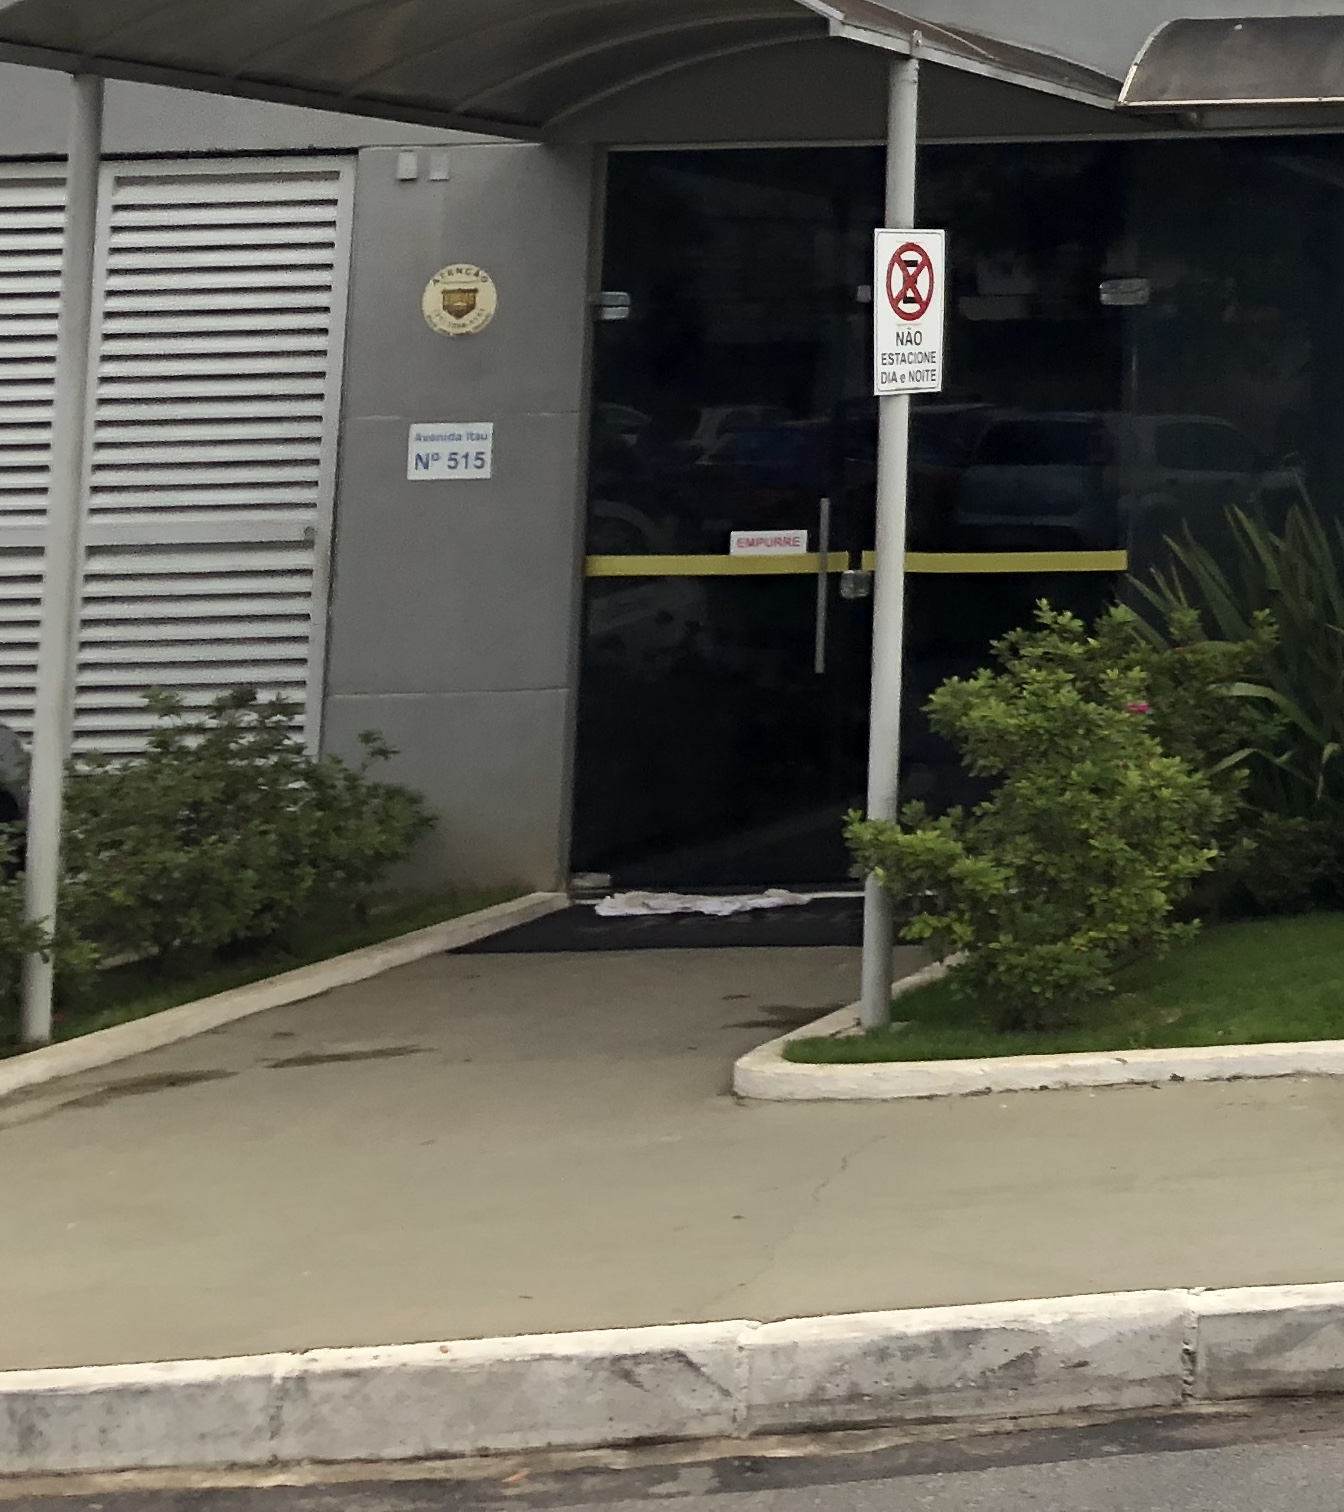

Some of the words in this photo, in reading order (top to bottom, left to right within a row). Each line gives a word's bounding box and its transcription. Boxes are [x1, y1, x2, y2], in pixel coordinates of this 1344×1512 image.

[896, 327, 923, 347] NÃO
[881, 350, 937, 367] ESTACIONE
[880, 370, 898, 385] DIA
[908, 368, 937, 383] NOITE
[447, 451, 486, 470] 515
[736, 536, 801, 549] EMPURRE
